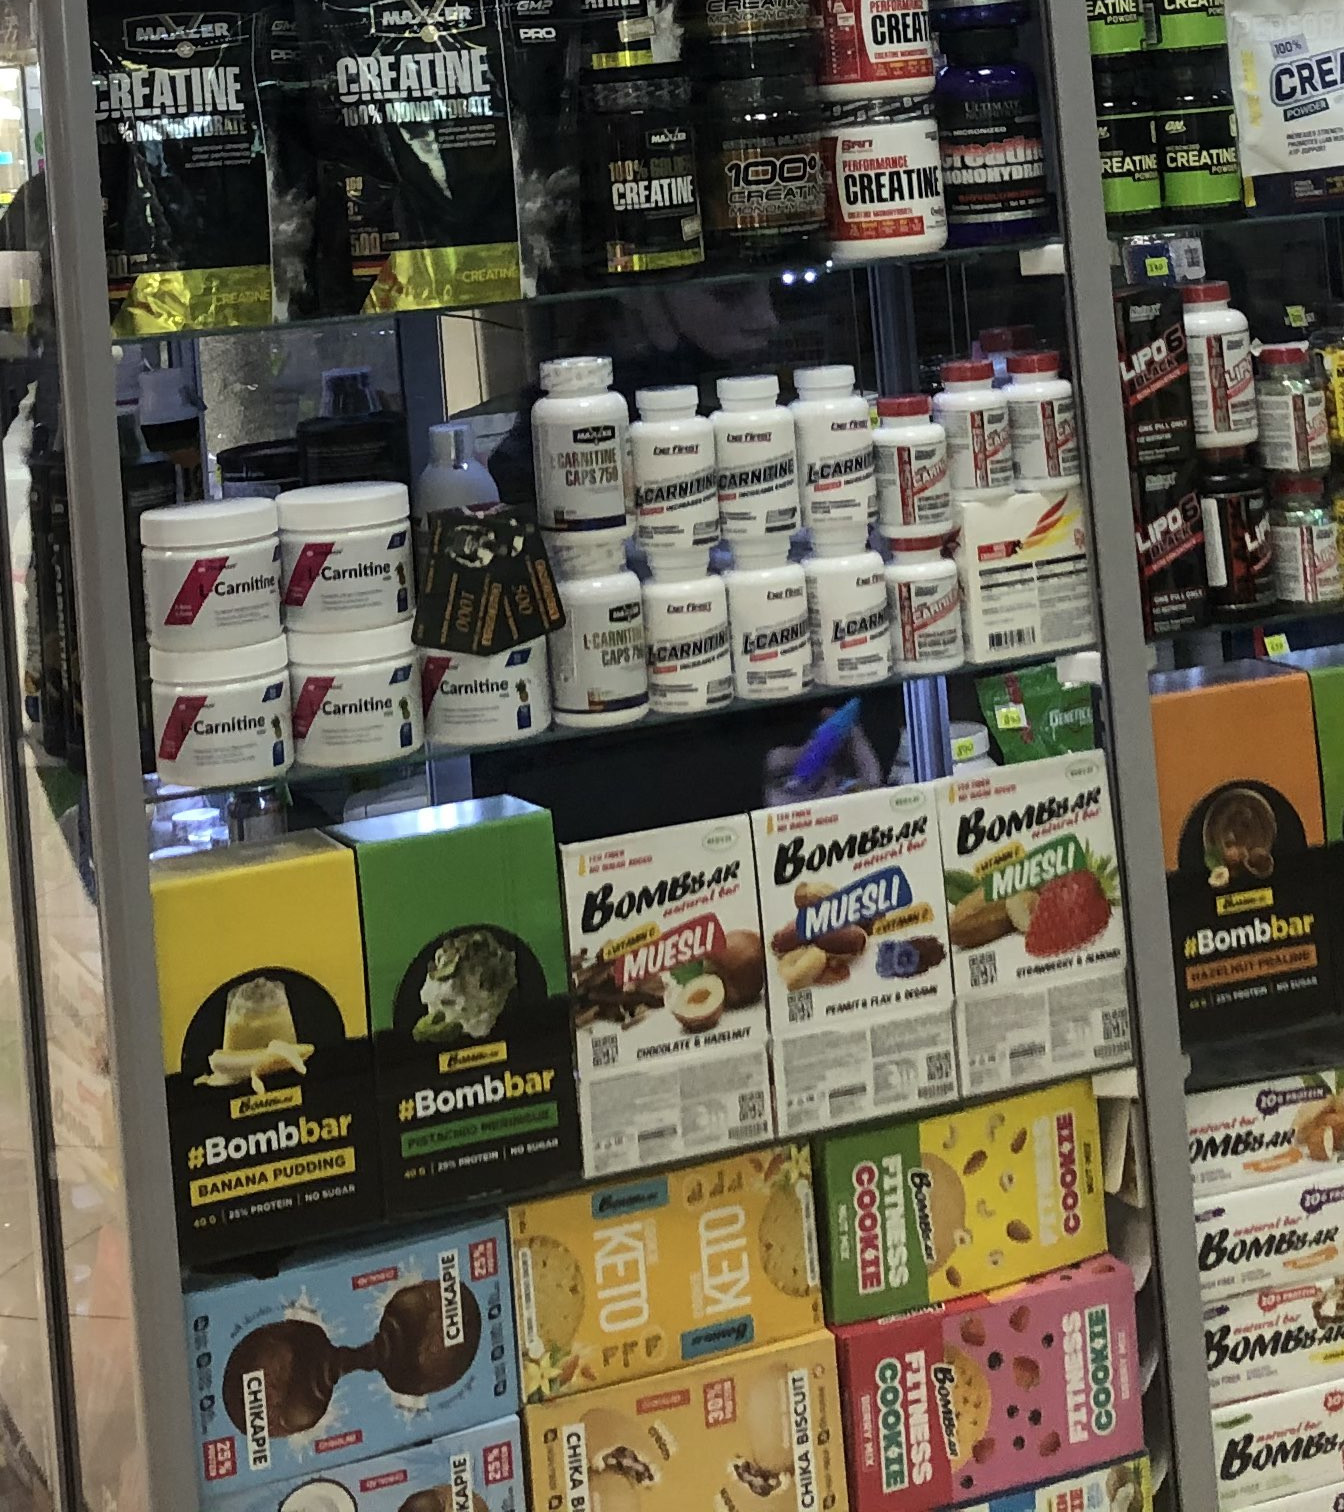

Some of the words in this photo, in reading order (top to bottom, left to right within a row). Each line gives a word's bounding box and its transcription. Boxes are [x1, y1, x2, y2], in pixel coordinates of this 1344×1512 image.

[136, 23, 229, 41] MAXLER
[383, 6, 471, 26] MAXLER
[520, 27, 555, 40] PRO
[1273, 39, 1302, 55] 100%
[92, 66, 244, 119] CREATINE
[337, 50, 490, 103] CREATINE
[135, 114, 246, 142] MONOHYDRATE
[342, 107, 382, 126] 100%
[387, 98, 492, 123] MONOHYDRATE
[1285, 100, 1328, 118] POWDER
[610, 159, 646, 179] 100%
[843, 155, 909, 172] PERFORMANCE
[1166, 147, 1237, 166] CREATINE
[612, 175, 694, 210] CREATINE
[844, 166, 940, 206] CREATINE
[566, 469, 595, 486] CAPS
[598, 465, 618, 484] 750
[602, 651, 629, 666] CAPS
[955, 787, 1102, 856] BOMBBAR
[773, 815, 928, 886] BOMBBAR
[991, 844, 1076, 900] MUESLI
[581, 859, 741, 934] BOMBBAR
[803, 874, 899, 940] MUESLI
[621, 921, 716, 985] MUESLI
[1184, 913, 1315, 959] #Bombbar
[825, 1000, 858, 1016] PEANUT
[870, 992, 891, 1007] FLAX
[636, 1039, 690, 1060] CHOCOLATE
[703, 1026, 751, 1046] HAZELNUT
[398, 1068, 554, 1122] #Bombbar
[187, 1113, 352, 1170] #Bombbar
[459, 1150, 499, 1166] PROTEIN
[510, 1144, 525, 1156] NO
[527, 1138, 559, 1154] SUGAR
[198, 1172, 269, 1198] BANANA
[273, 1154, 346, 1180] PUDDING
[250, 1198, 293, 1214] PROTEIN
[305, 1192, 318, 1202] NO
[322, 1185, 356, 1200] SUGAR
[1056, 1111, 1081, 1235] COOKIE
[853, 1163, 885, 1295] COOKIE
[881, 1153, 909, 1289] FITNESS
[700, 1204, 752, 1314] KETO
[1198, 1224, 1339, 1272] BOMBBAR
[445, 1252, 462, 1344] CHIKAPIE
[593, 1221, 650, 1334] KETO
[1062, 1311, 1089, 1445] FITNESS
[1086, 1304, 1115, 1434] COOKIE
[246, 1374, 271, 1467] CHIKAPIE
[791, 1374, 812, 1432] BISCUIT
[877, 1358, 908, 1494] COOKIE
[905, 1350, 932, 1486] FITNESS
[565, 1431, 583, 1489] CHIKA
[800, 1436, 815, 1509] CHIKA
